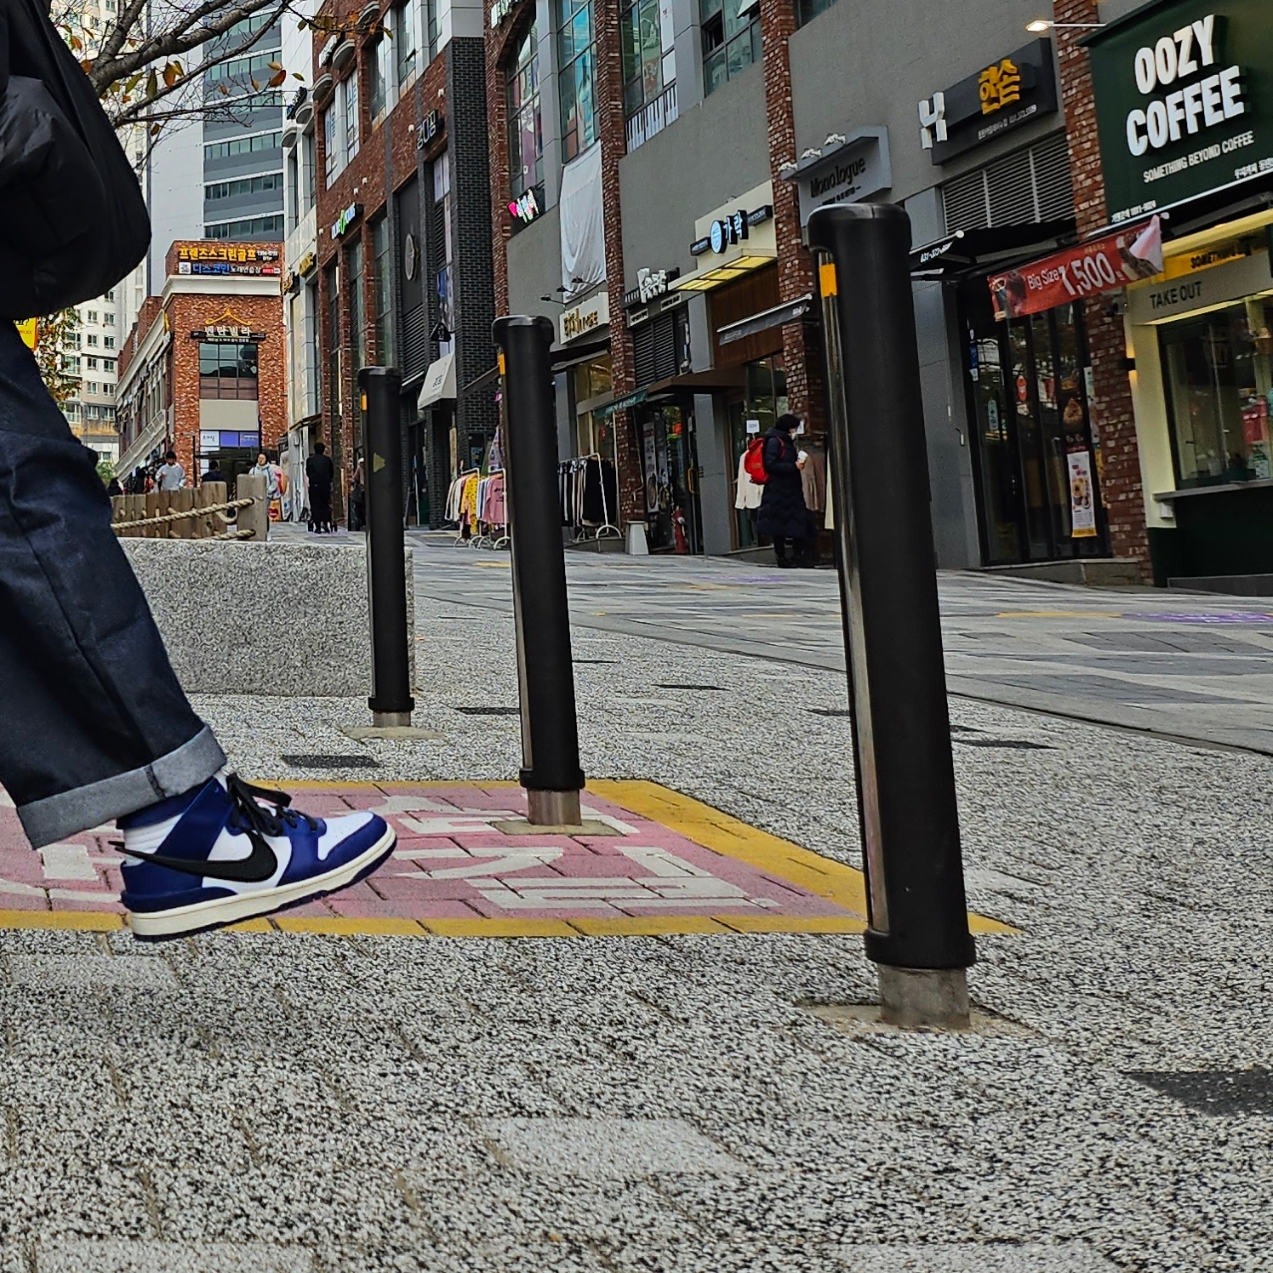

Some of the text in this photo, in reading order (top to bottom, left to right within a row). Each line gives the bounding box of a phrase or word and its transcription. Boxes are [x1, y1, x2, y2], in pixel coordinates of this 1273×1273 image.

[1135, 13, 1217, 96] OOZY
[1126, 64, 1247, 158] COFFEE
[809, 156, 867, 199] Monologue
[1143, 130, 1255, 184] SOMETHING BEYOND COFFEE
[179, 247, 257, 262] 프렌즈스크린골프
[1027, 272, 1041, 291] Big
[1041, 268, 1060, 288] Size
[1149, 281, 1203, 309] TAKE OUT
